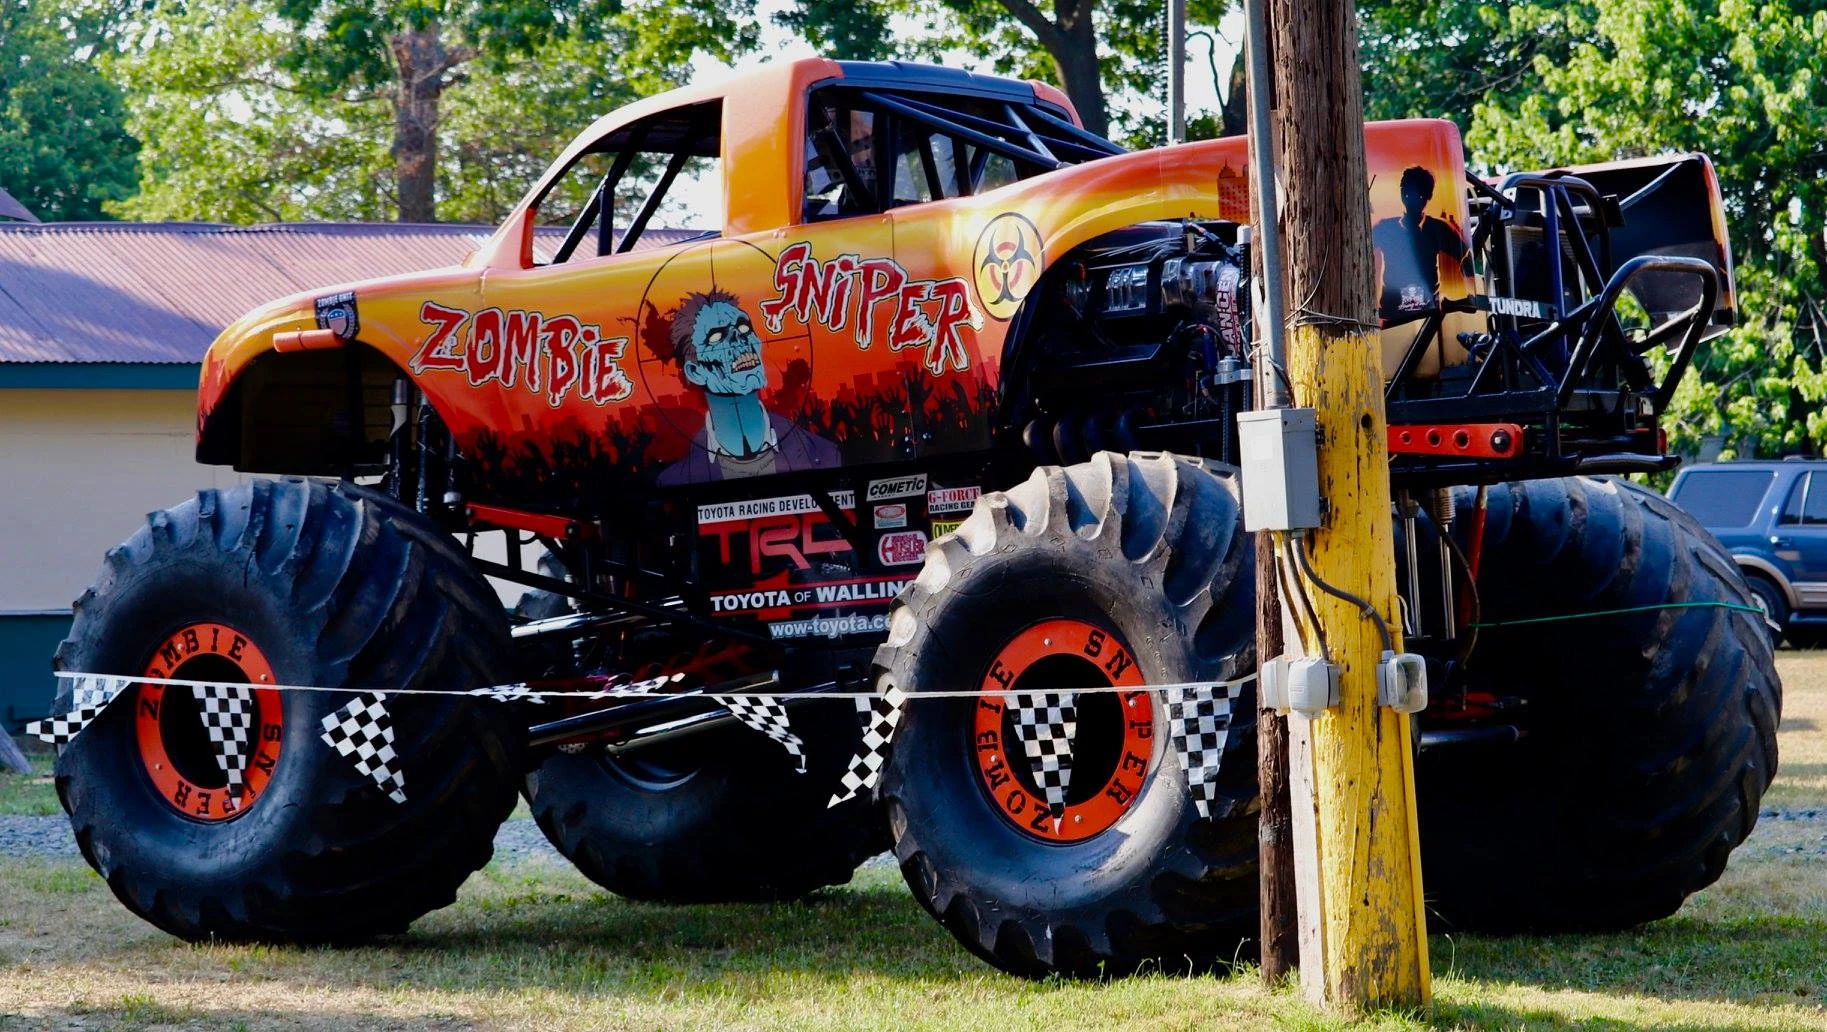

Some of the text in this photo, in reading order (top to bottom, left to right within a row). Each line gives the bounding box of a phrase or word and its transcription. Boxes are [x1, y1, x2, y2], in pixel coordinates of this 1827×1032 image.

[1489, 297, 1541, 318] TUNDRA
[698, 506, 735, 520] TOYOTA
[739, 501, 776, 516] RACING
[779, 494, 856, 512] DEVELOENT
[930, 502, 959, 511] RACING
[710, 590, 791, 612] TOYOTA
[794, 591, 812, 603] OF
[139, 628, 248, 720] ZOMBIE
[976, 660, 1052, 833] ZOMBIE
